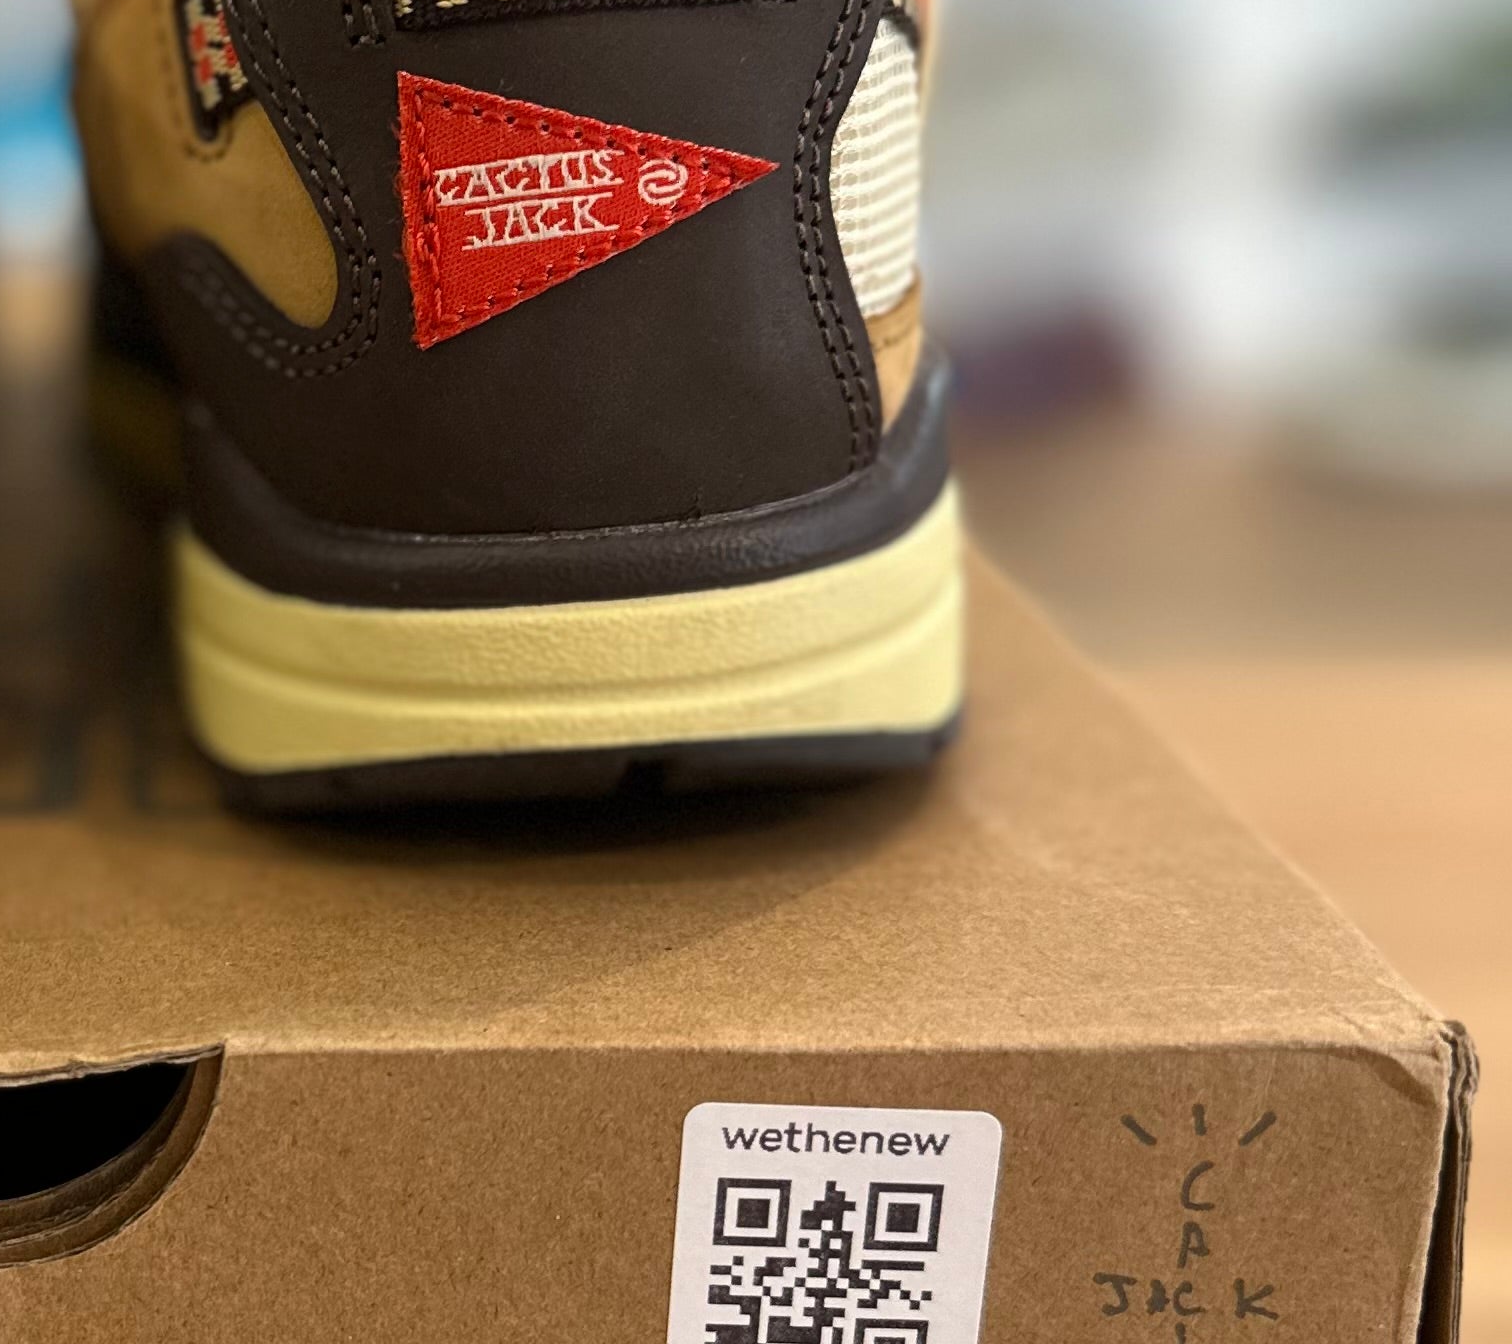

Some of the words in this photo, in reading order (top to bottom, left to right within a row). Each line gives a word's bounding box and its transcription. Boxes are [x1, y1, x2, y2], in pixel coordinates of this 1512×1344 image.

[434, 149, 625, 208] CACTUS
[461, 192, 620, 251] JACK
[722, 1121, 950, 1156] wethenew
